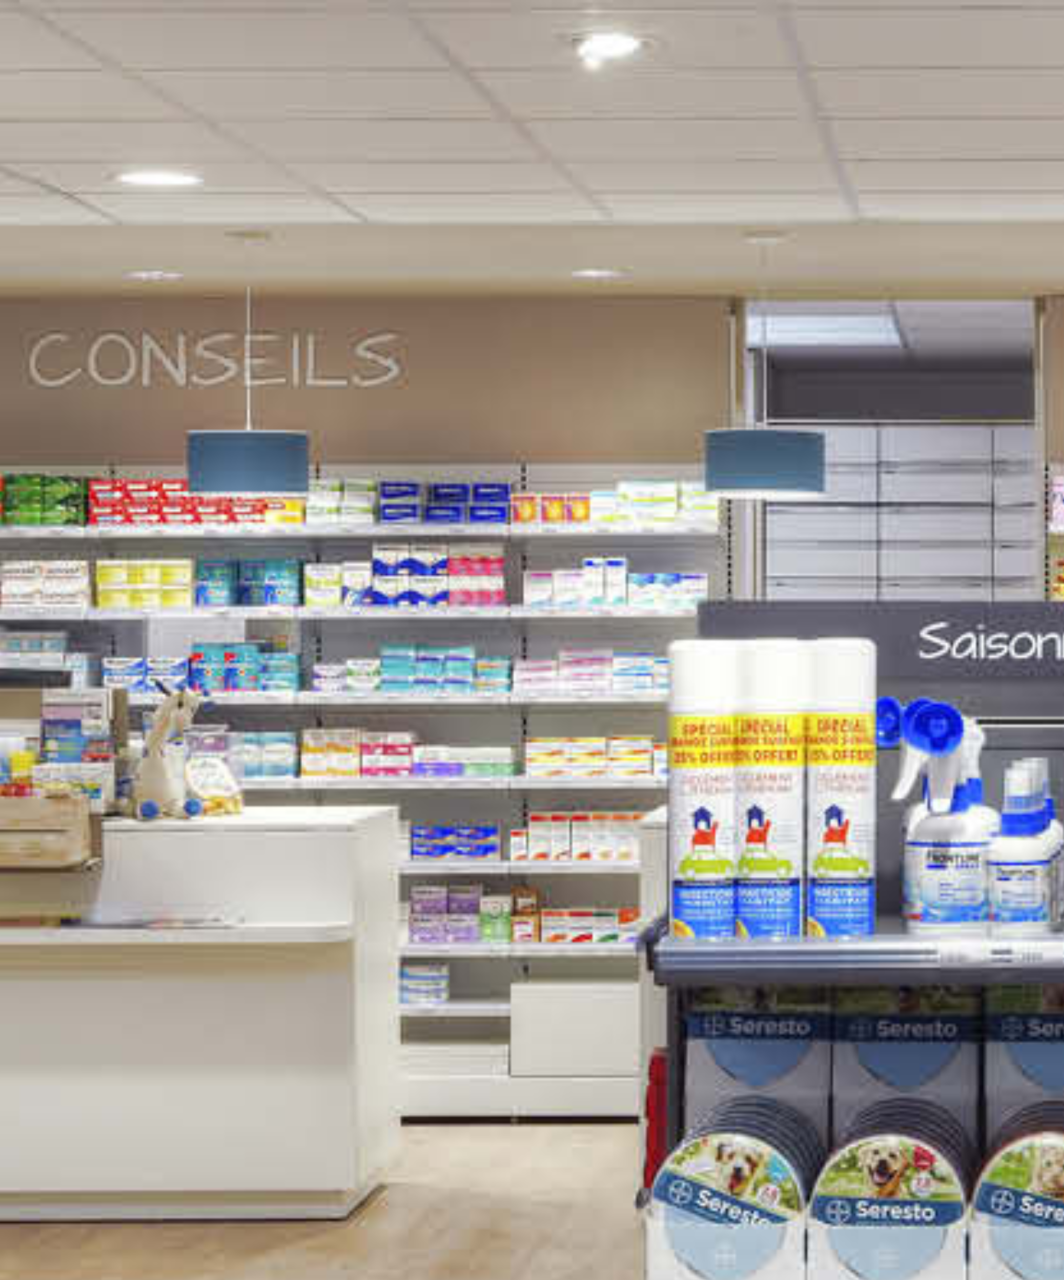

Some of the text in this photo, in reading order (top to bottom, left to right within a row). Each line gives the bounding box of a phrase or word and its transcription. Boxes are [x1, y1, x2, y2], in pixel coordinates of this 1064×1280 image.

[29, 332, 401, 388] CONSEILS
[730, 1016, 811, 1036] Seresto
[877, 1017, 958, 1038] Seresto
[856, 1202, 936, 1222] Seresto
